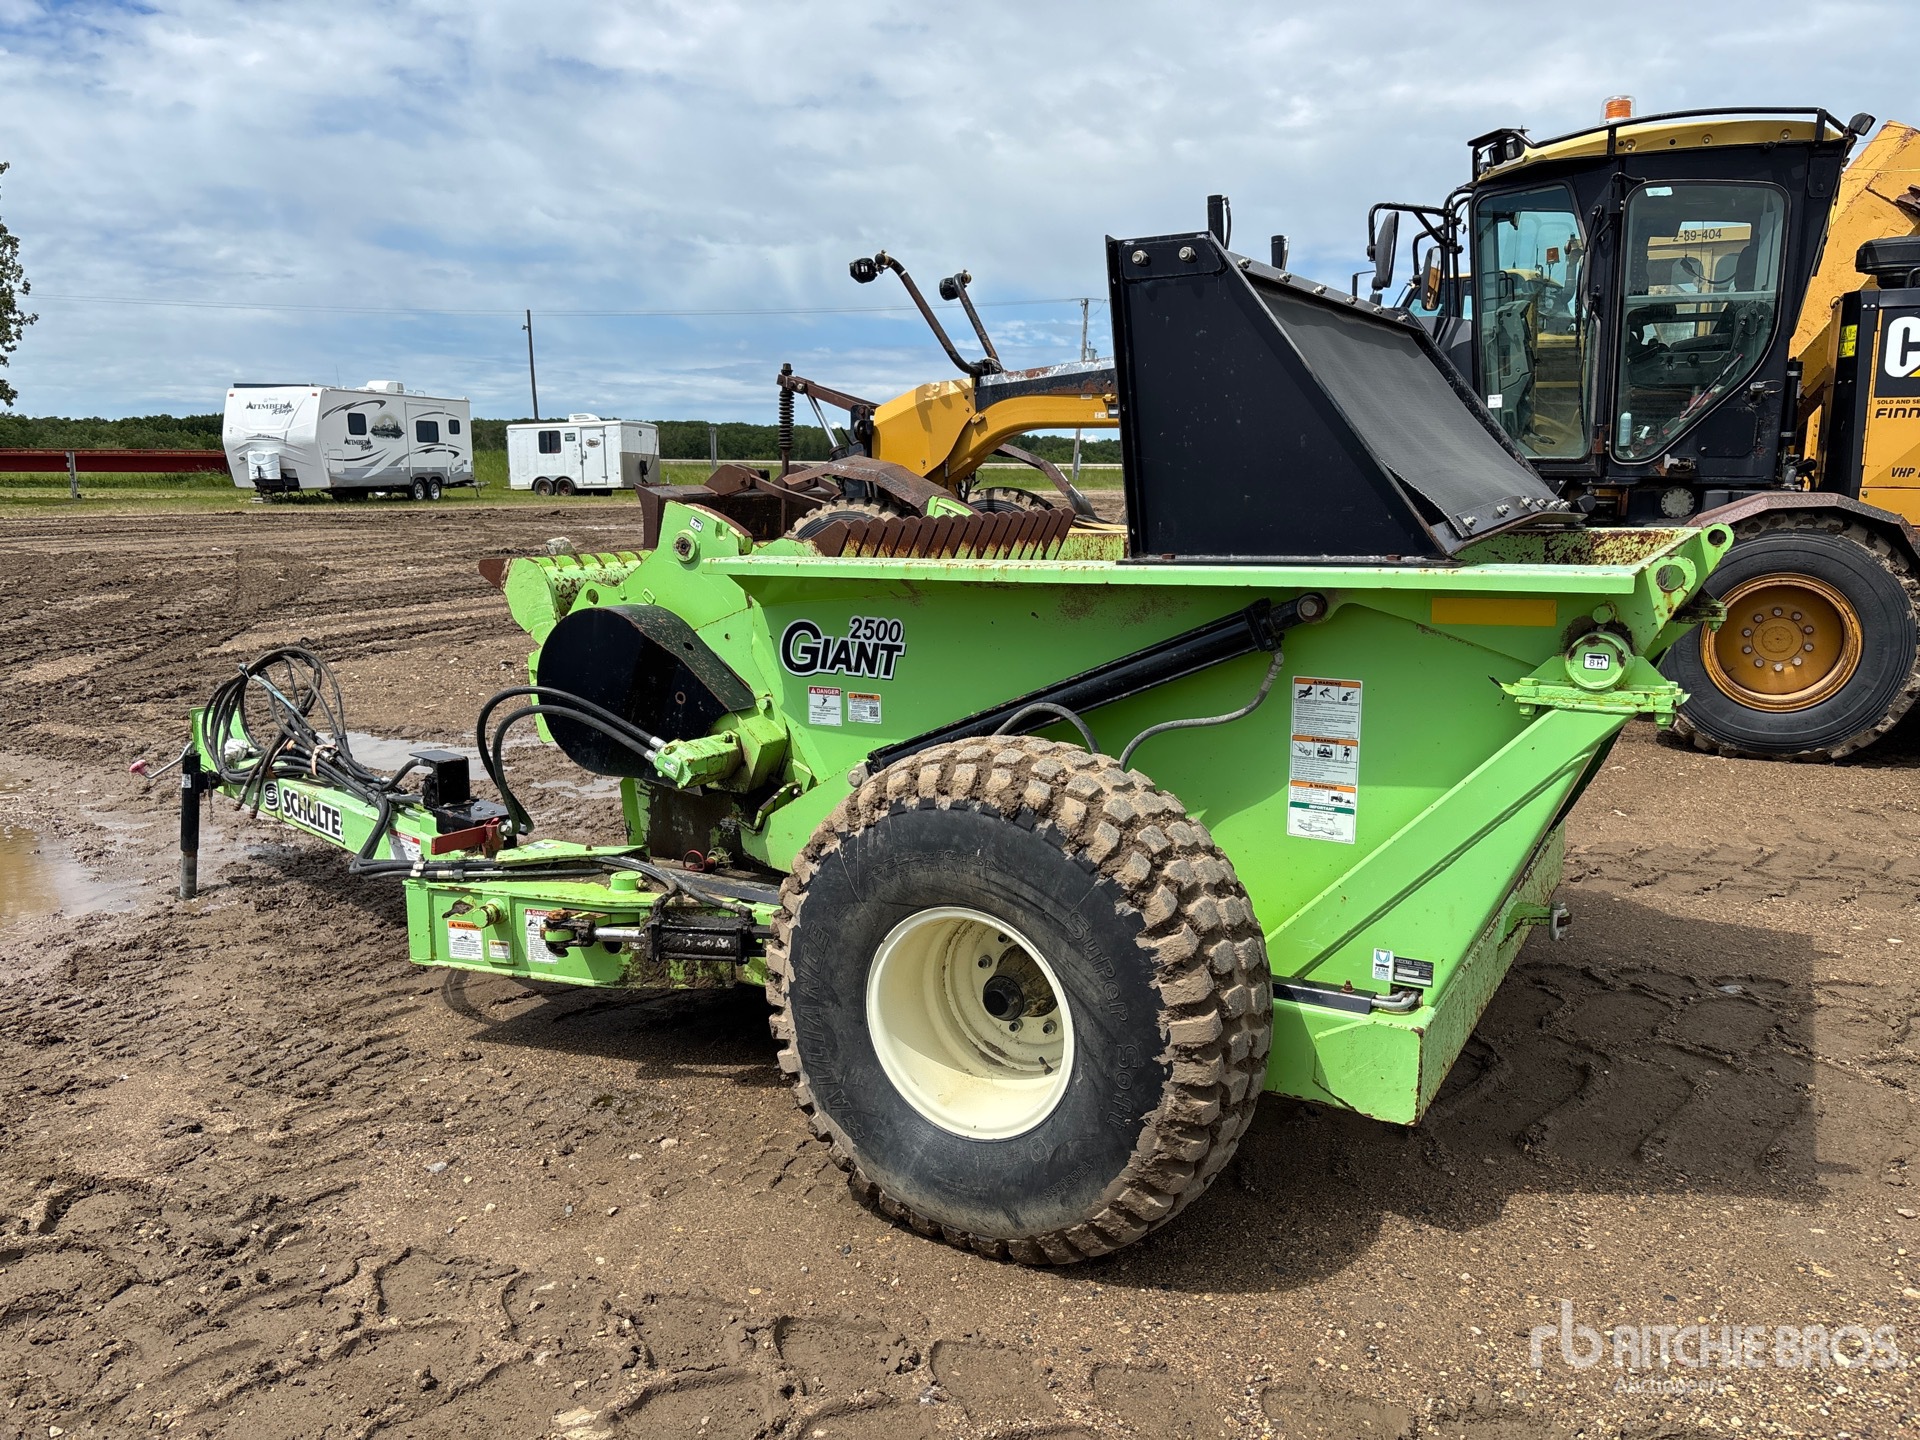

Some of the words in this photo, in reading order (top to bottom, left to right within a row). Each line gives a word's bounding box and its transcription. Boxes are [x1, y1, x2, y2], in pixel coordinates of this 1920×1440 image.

[1891, 467, 1916, 478] VHP
[849, 617, 903, 643] 2500
[282, 788, 342, 836] SCHULTE
[800, 919, 852, 1111] ALLIANCE
[1043, 1160, 1095, 1200] TUBELESS
